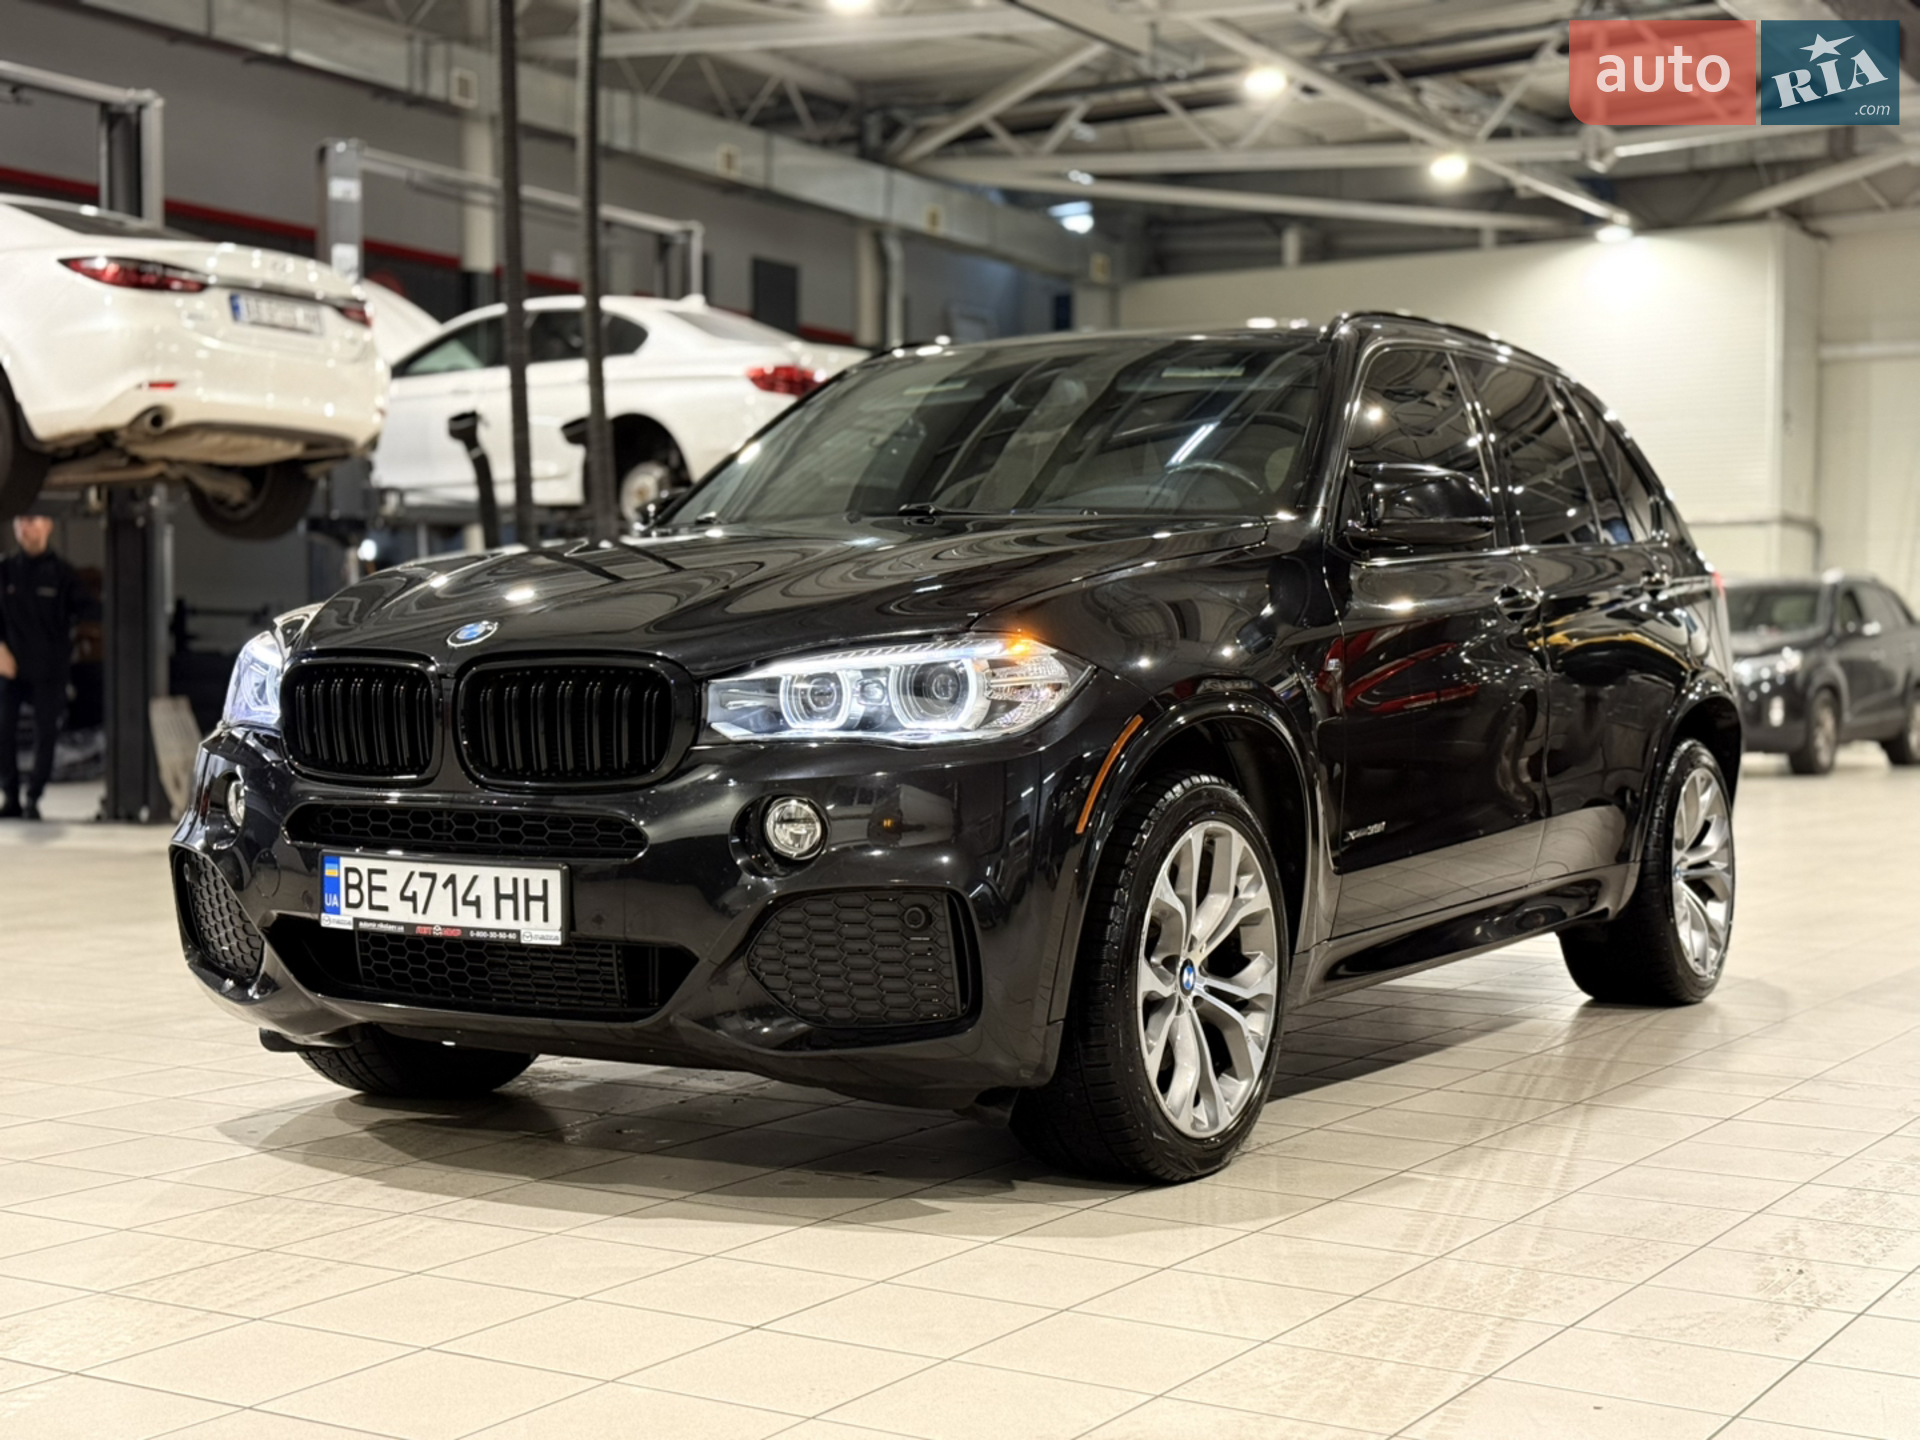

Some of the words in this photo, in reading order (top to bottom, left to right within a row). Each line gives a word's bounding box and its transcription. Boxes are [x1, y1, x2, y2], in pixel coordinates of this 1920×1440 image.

[324, 893, 339, 908] UA
[344, 866, 390, 912] BE
[399, 871, 482, 919] 4714
[493, 876, 549, 923] HH
